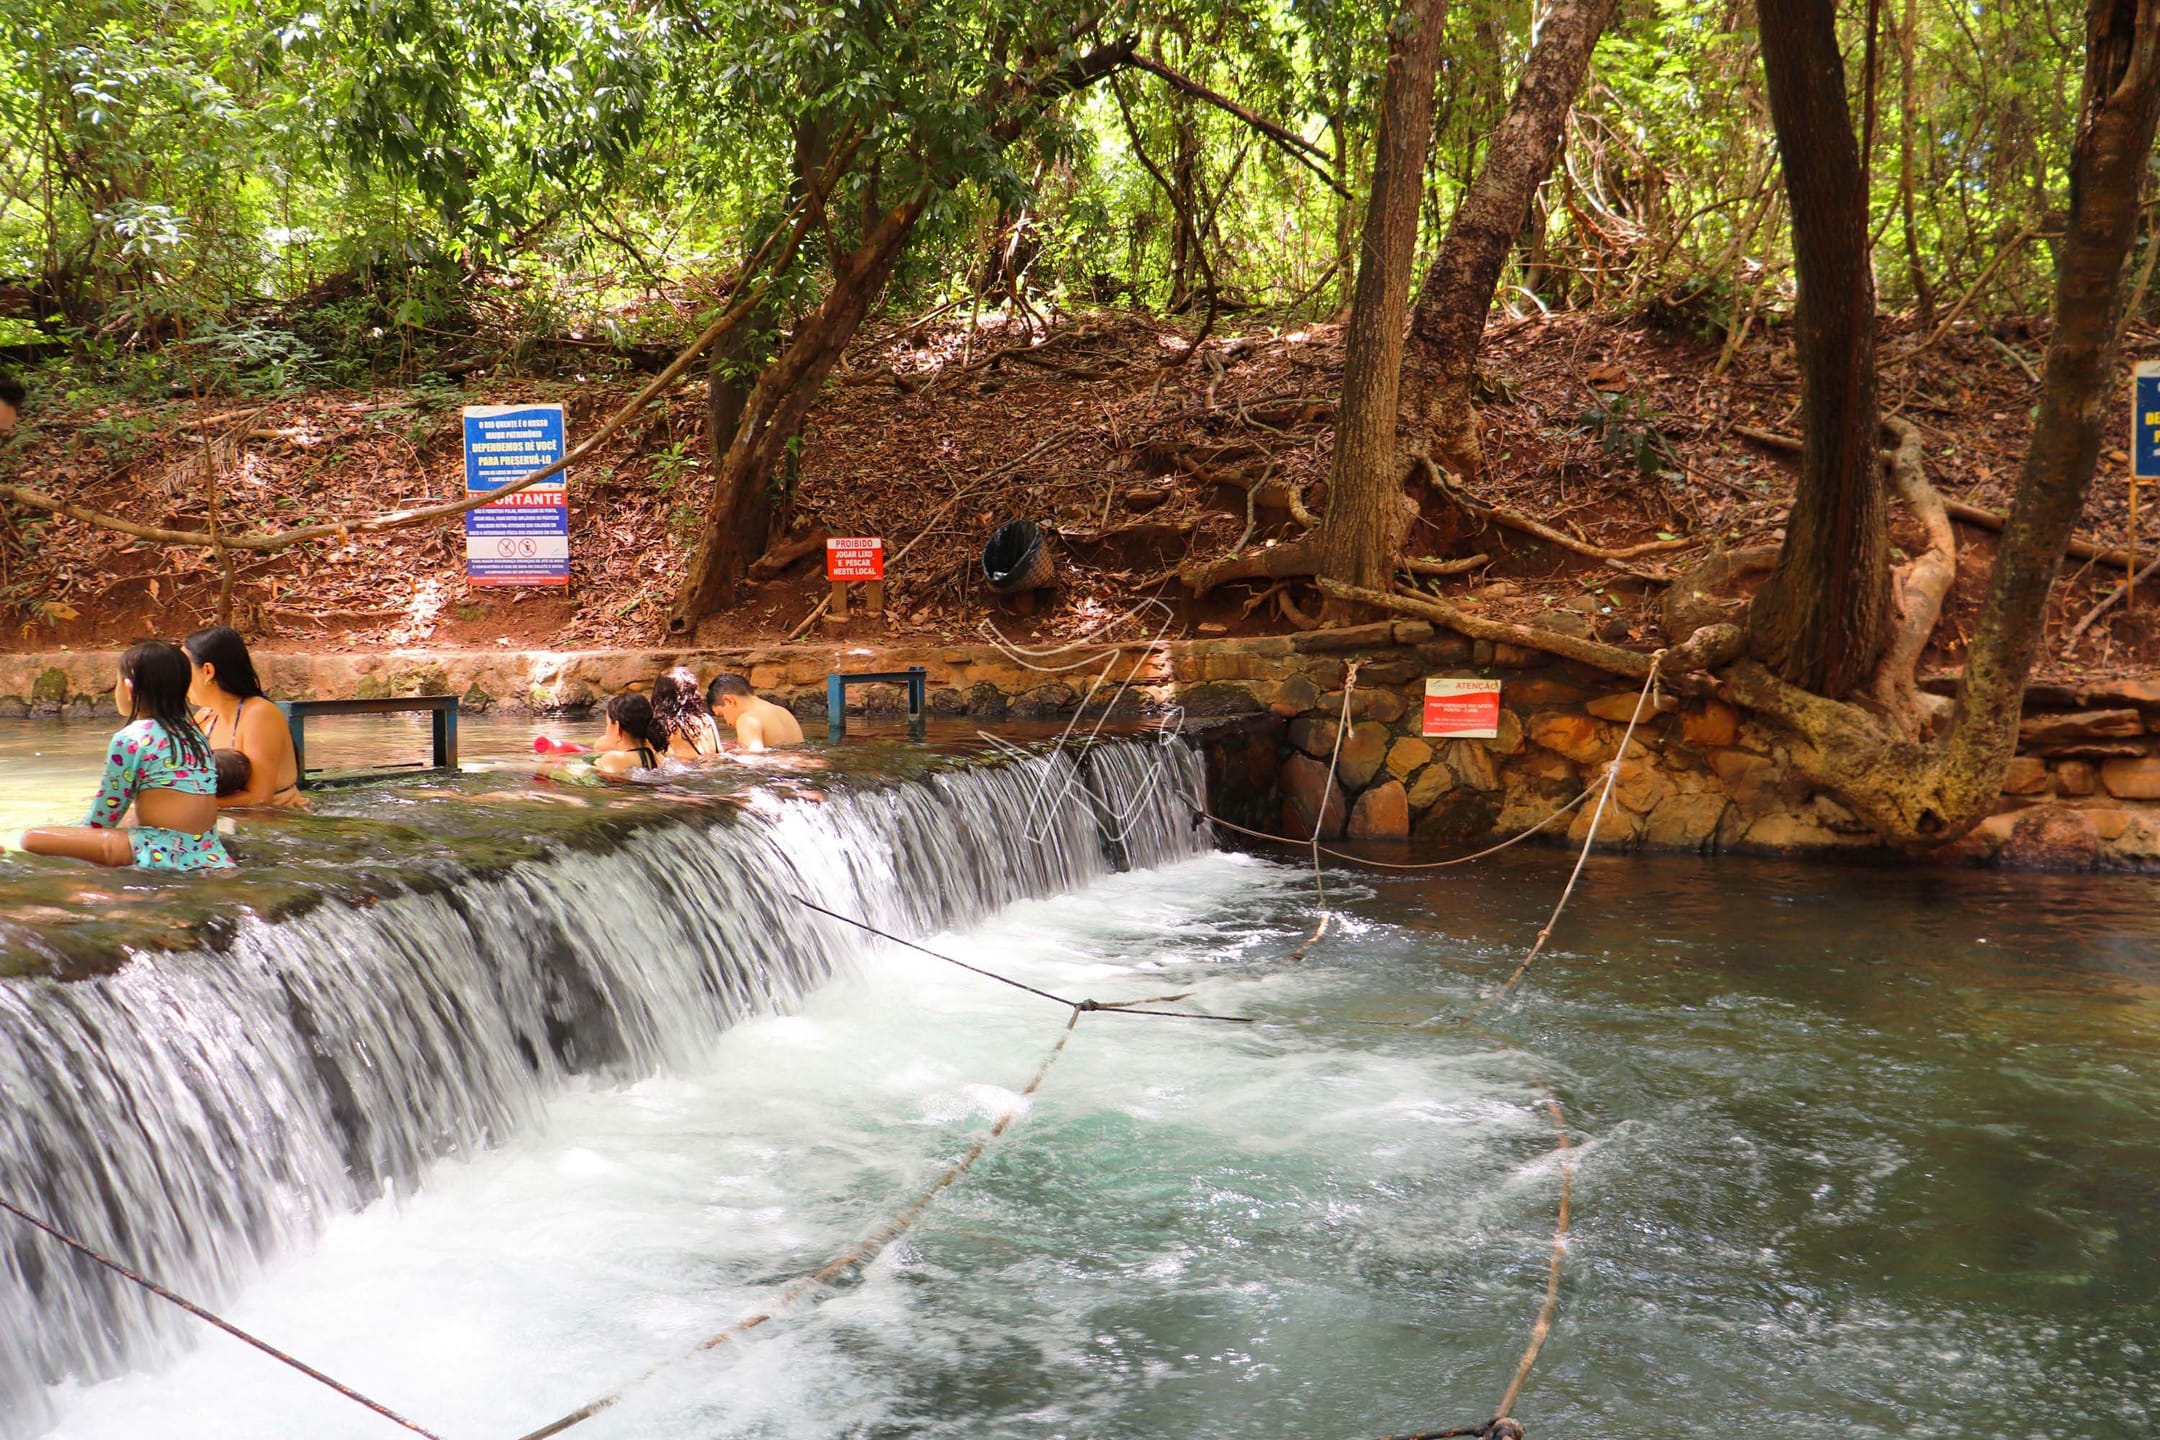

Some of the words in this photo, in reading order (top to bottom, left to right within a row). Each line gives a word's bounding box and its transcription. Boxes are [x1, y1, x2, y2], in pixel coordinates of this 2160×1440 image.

[472, 442, 524, 453] DEPENDEMOS
[536, 439, 557, 451] VOCÊ
[478, 456, 499, 466] PARA
[500, 454, 552, 466] PRESERVÁ-LO
[835, 540, 873, 548] PROIBIDO
[858, 550, 873, 558] LIXO
[1456, 681, 1498, 690] ATENÇÃO
